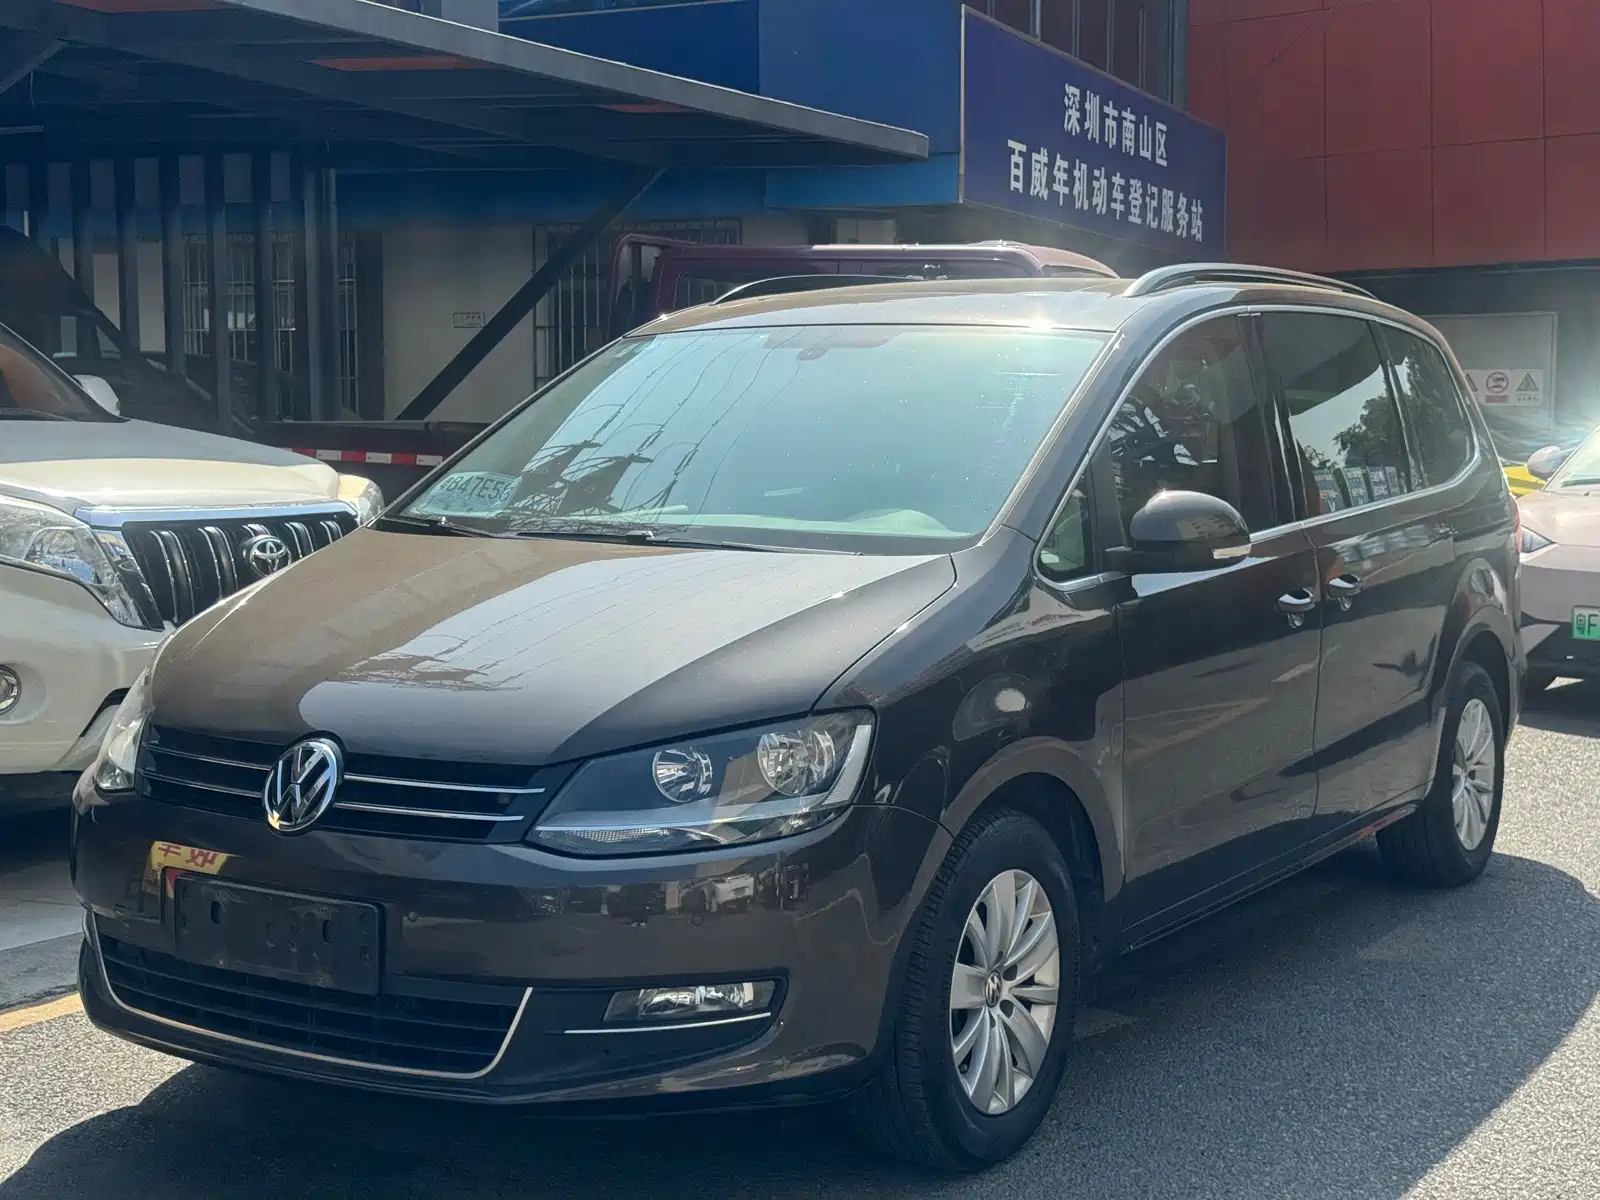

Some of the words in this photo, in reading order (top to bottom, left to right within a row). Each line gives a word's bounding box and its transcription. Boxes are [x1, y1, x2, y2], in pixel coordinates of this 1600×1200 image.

[1063, 83, 1168, 167] 深圳市南山区
[1007, 139, 1204, 242] 百威年机动车登记服务站
